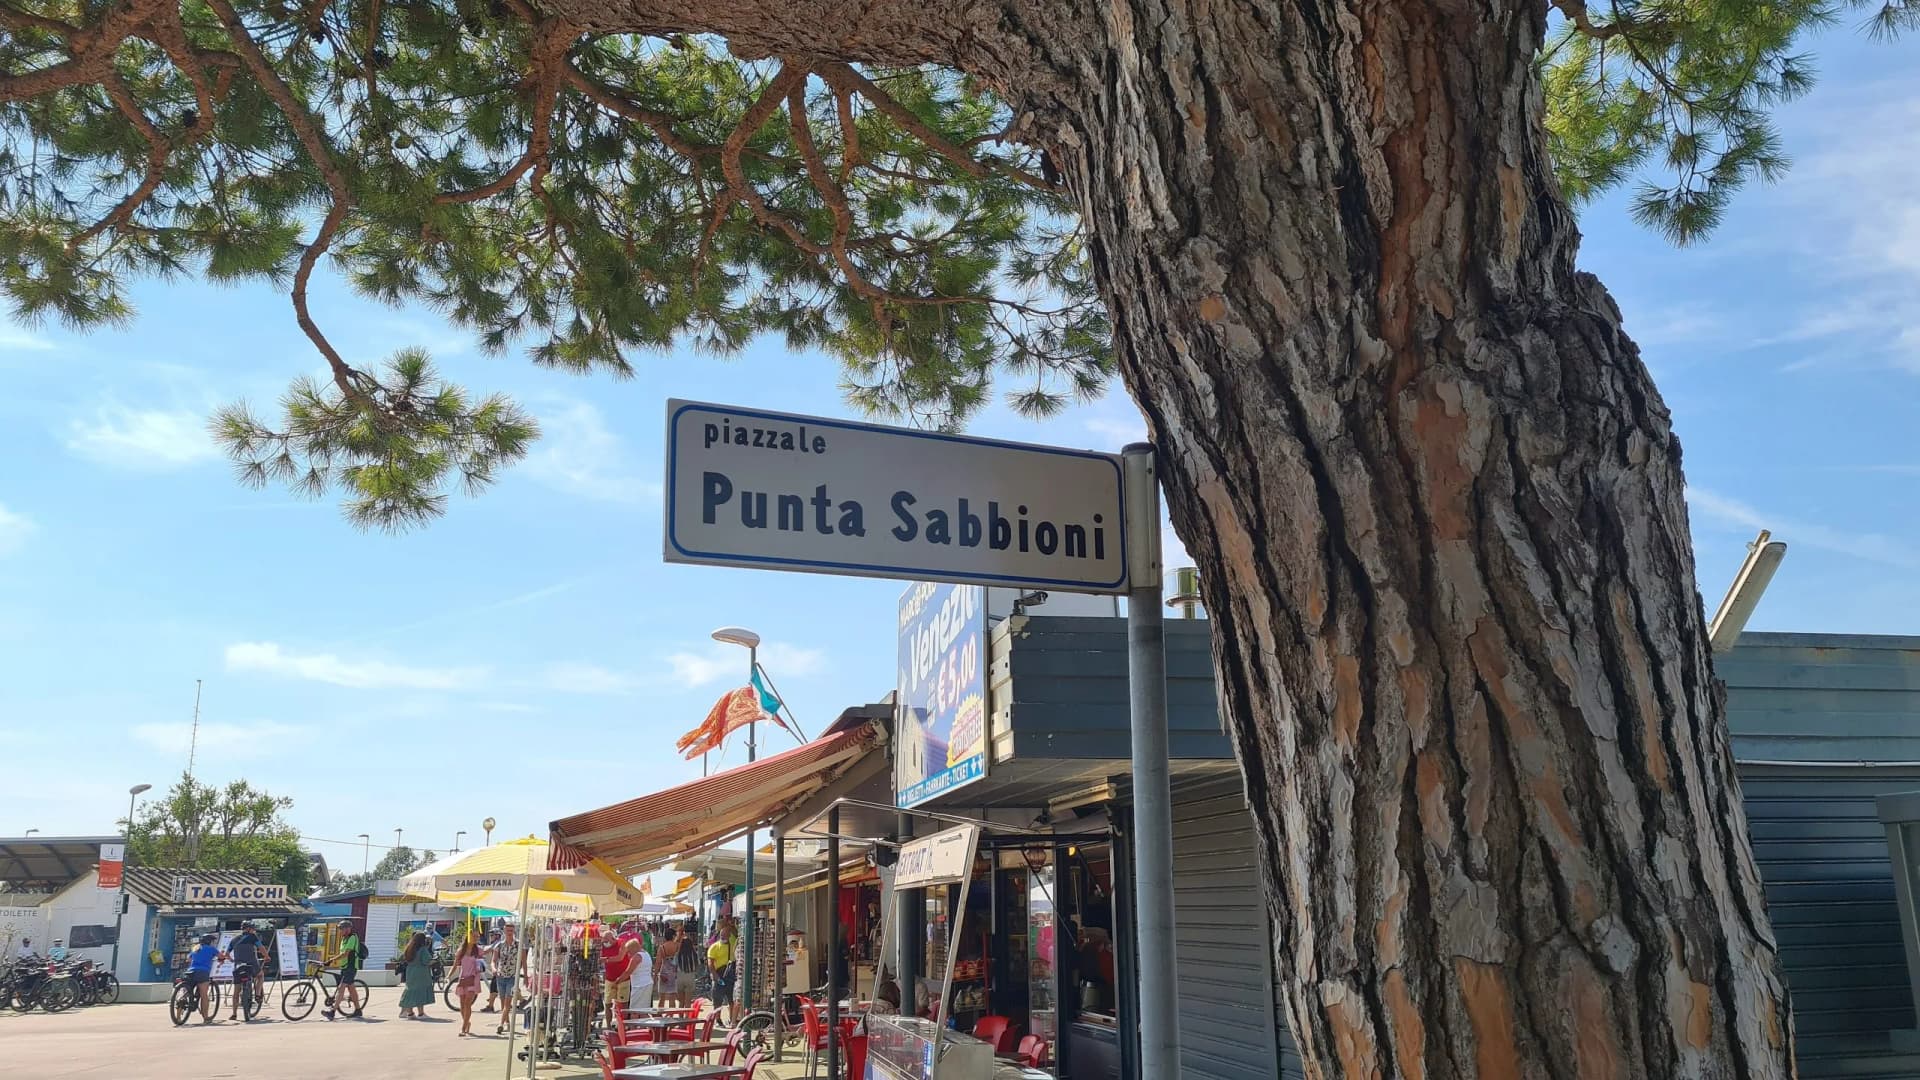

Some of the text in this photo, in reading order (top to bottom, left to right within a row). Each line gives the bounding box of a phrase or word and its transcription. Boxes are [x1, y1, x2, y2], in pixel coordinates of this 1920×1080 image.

[705, 418, 826, 455] piazzale
[702, 471, 1105, 560] Punta Sabbioni
[191, 886, 284, 899] TABACCHI
[455, 879, 512, 888] SAMMONTANA
